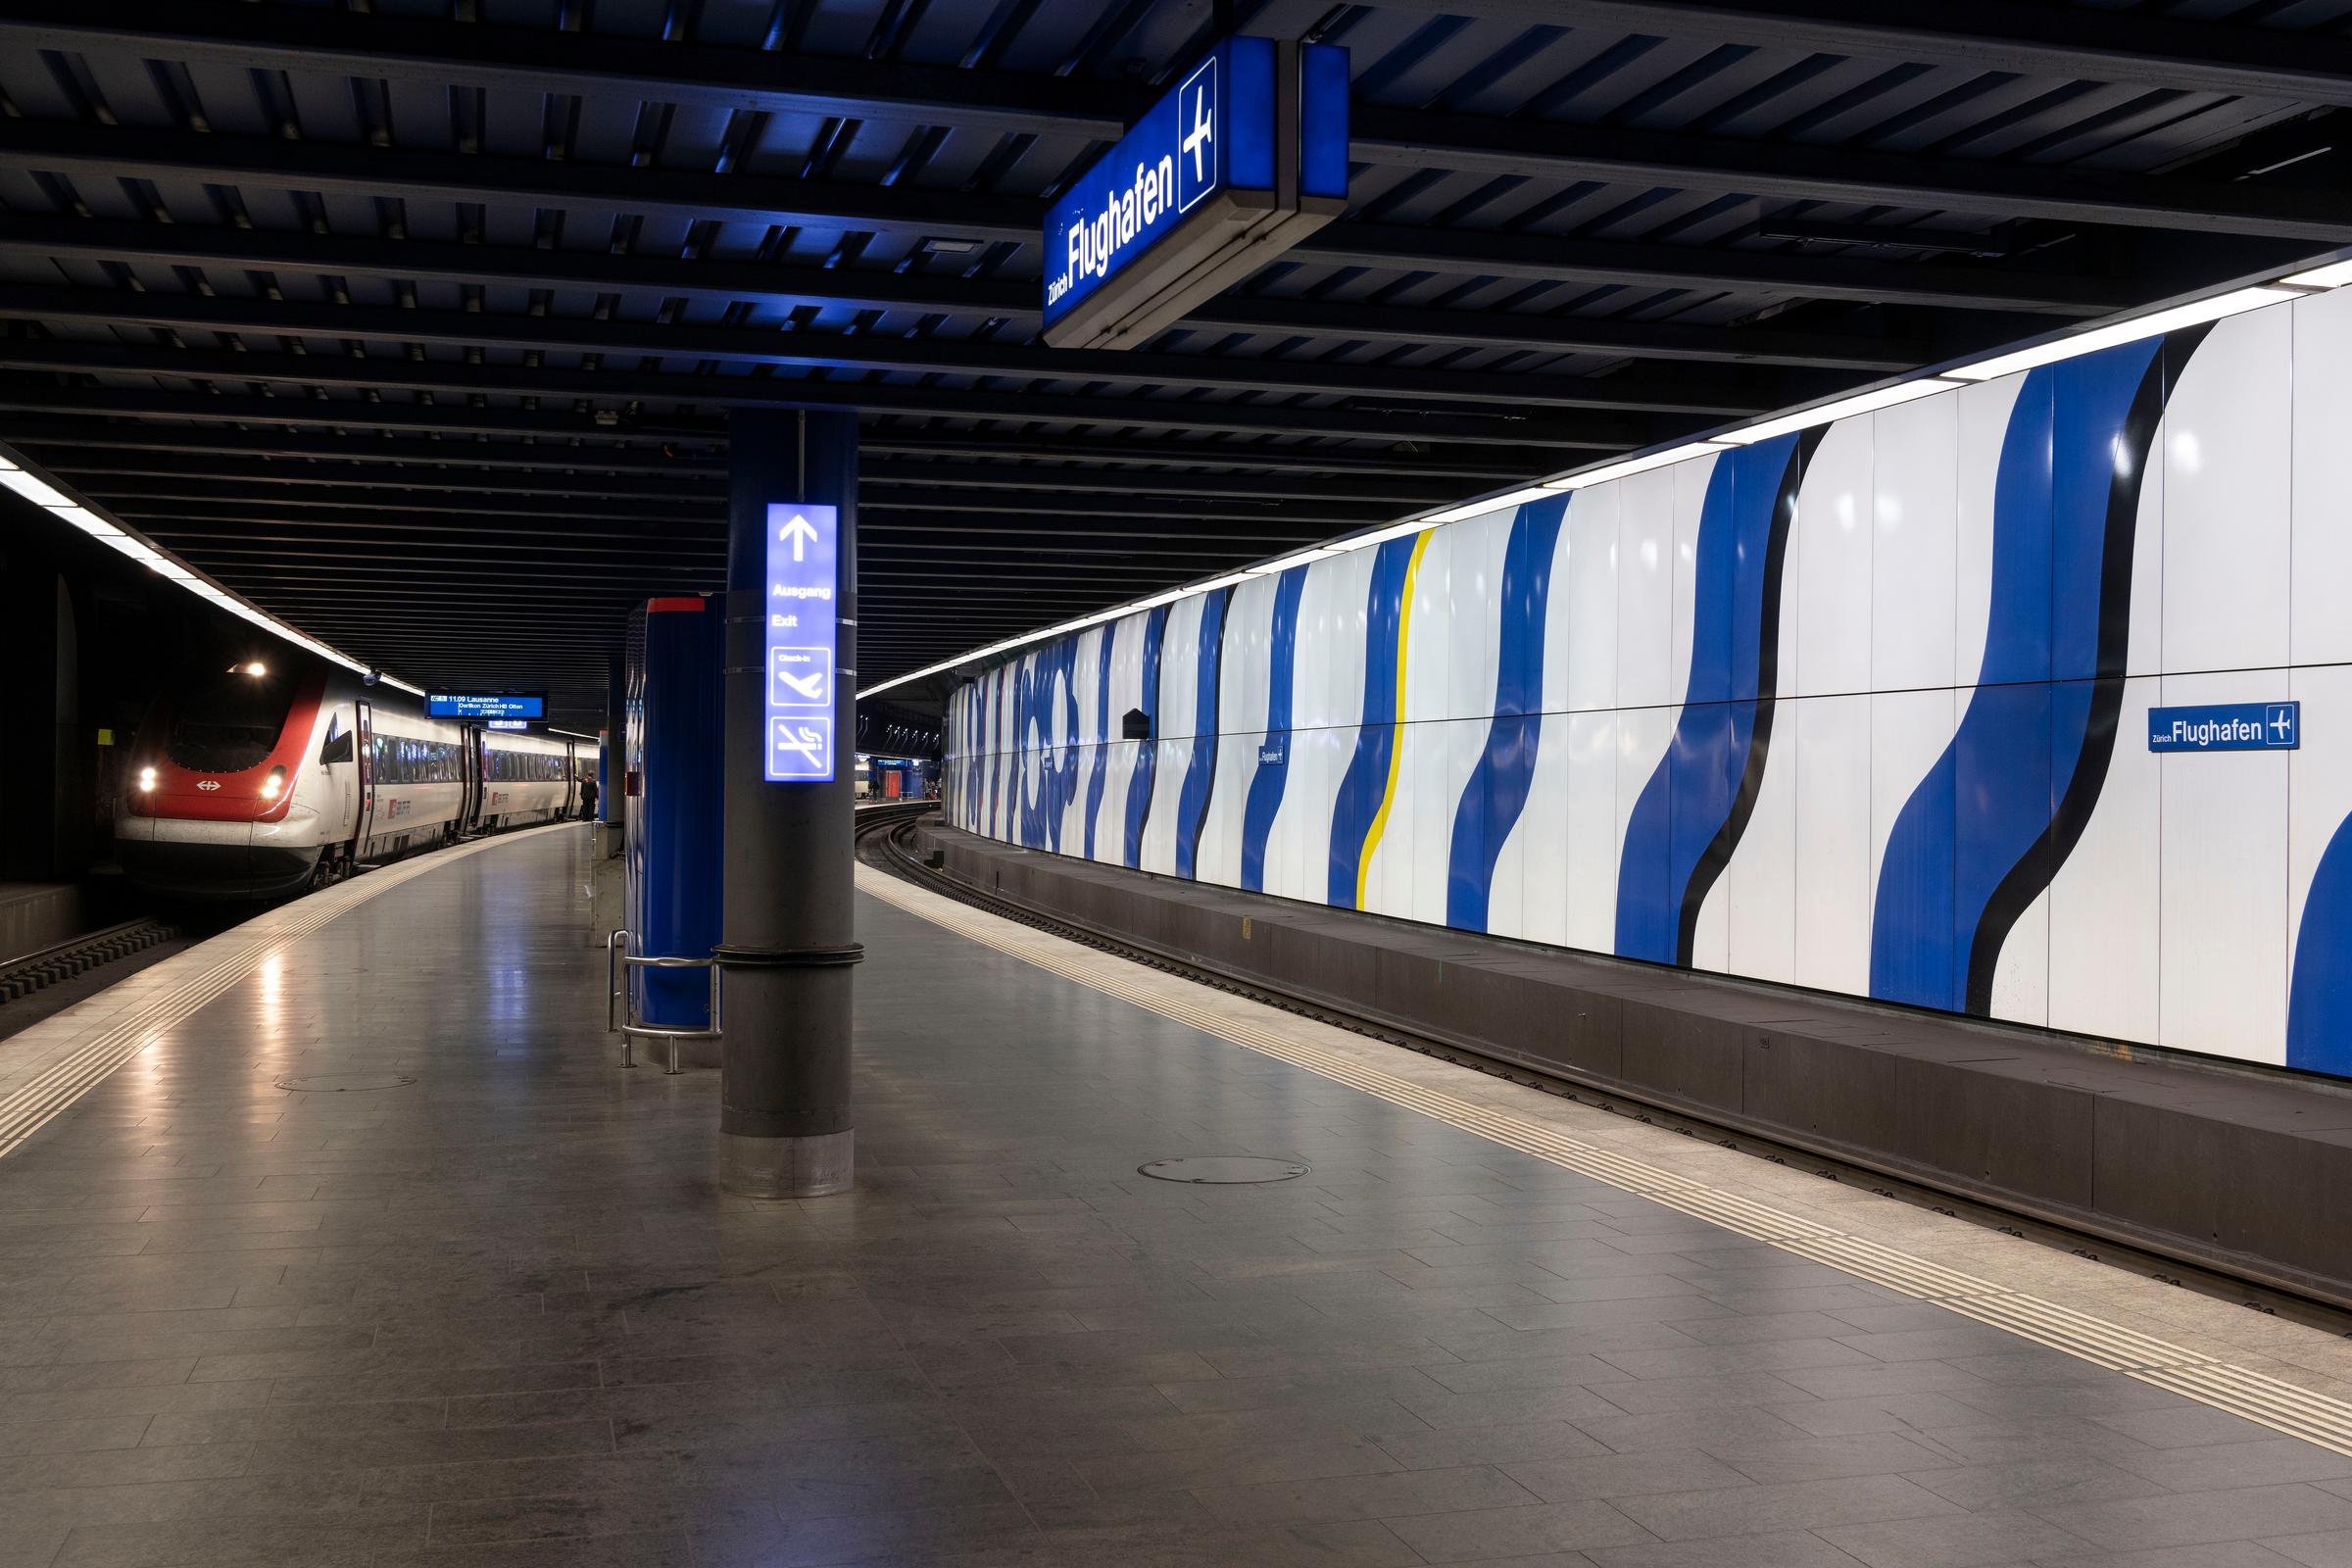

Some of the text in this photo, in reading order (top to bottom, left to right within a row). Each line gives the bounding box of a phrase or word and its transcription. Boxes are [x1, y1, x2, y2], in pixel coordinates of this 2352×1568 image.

[1048, 154, 1173, 307] Zürich Flughafen
[772, 584, 831, 600] Ausgang
[771, 614, 798, 627] Exit
[2152, 718, 2262, 746] Zürich Flughafen
